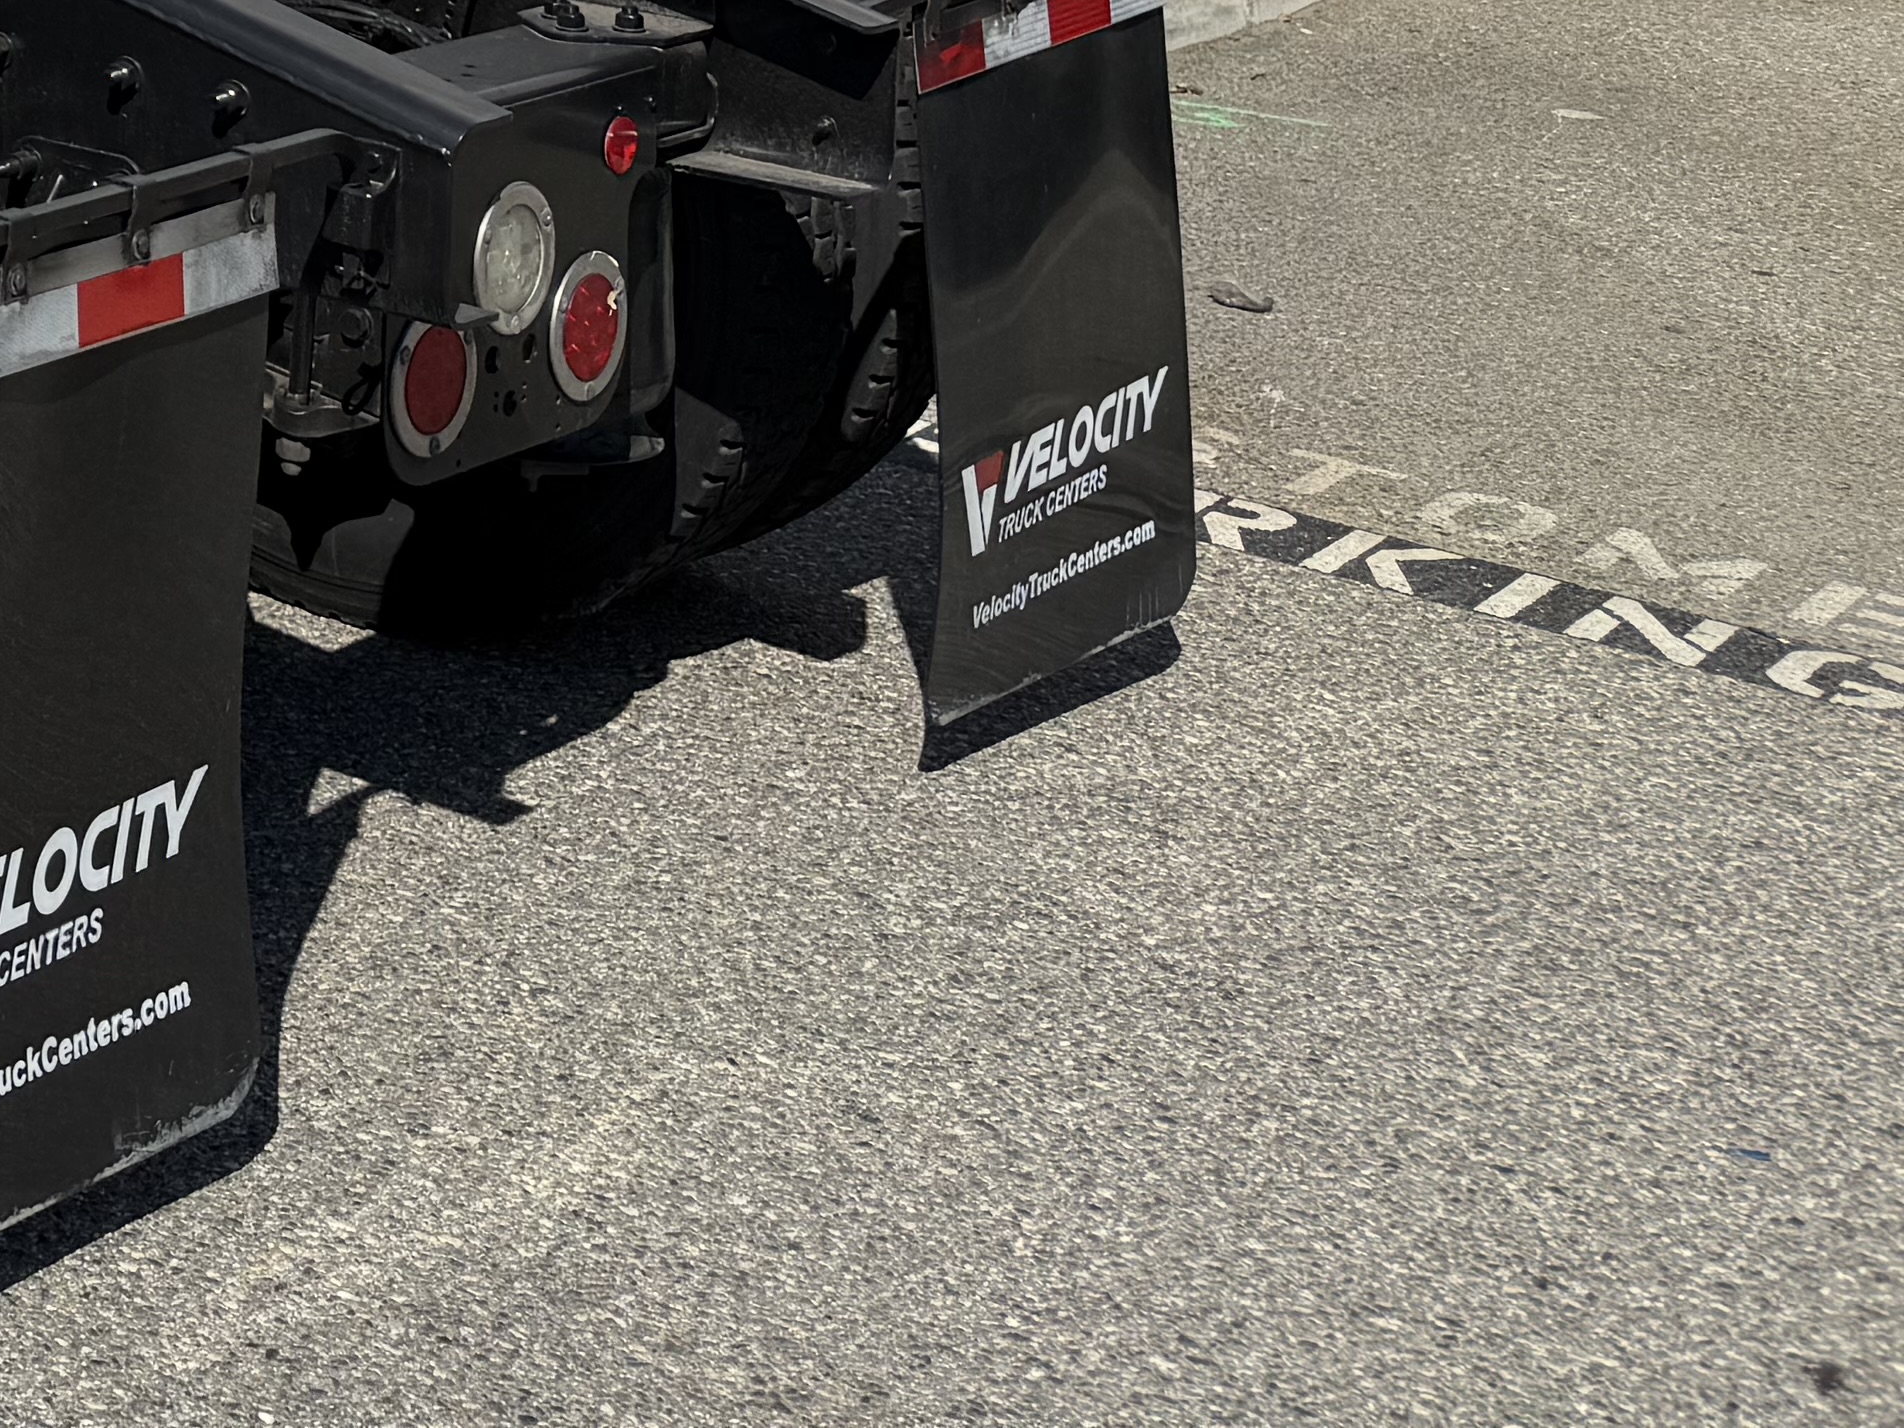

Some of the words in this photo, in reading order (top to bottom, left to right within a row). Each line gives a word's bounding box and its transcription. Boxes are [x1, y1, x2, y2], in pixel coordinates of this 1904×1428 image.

[1003, 365, 1169, 504] VELOCITY
[997, 495, 1044, 543] TRUCK
[1045, 464, 1108, 517] CENTERS
[972, 520, 1156, 629] VelocityTruckCenters.com
